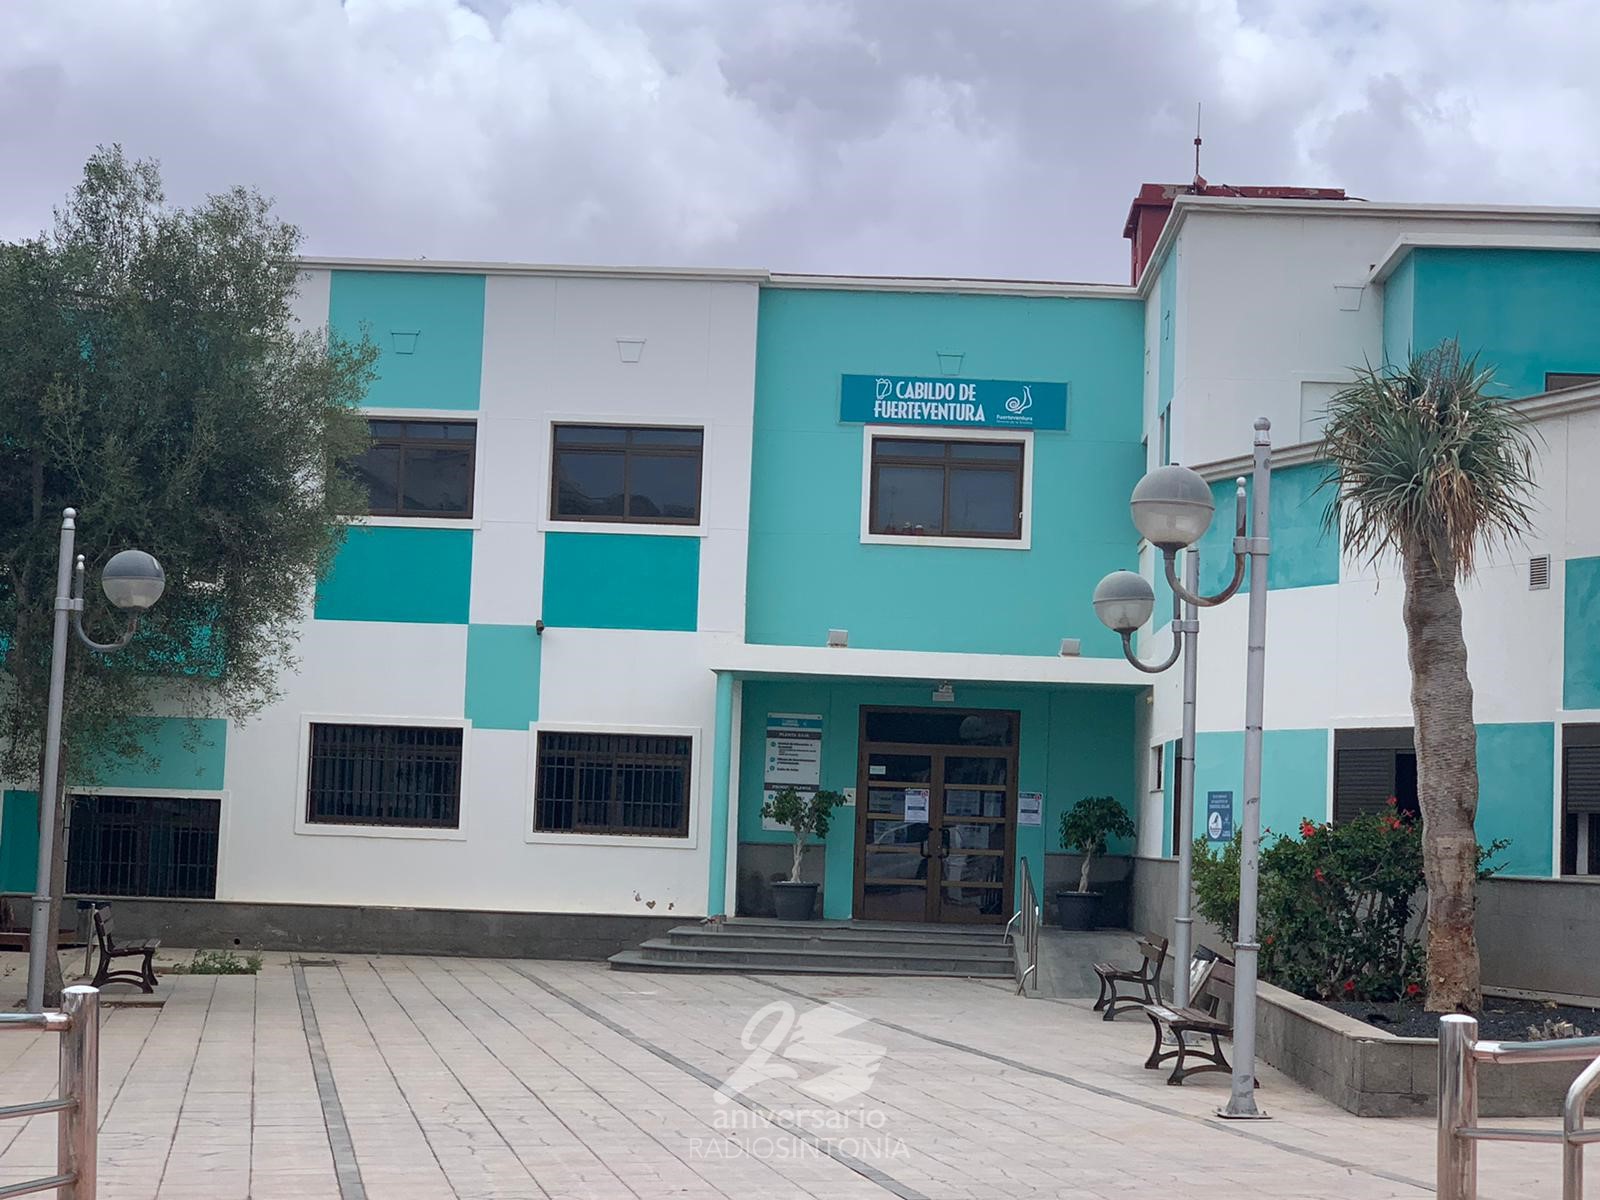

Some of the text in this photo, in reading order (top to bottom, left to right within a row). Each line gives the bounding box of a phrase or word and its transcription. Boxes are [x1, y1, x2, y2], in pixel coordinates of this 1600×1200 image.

[895, 381, 976, 402] CABILDO DE
[874, 400, 985, 422] FUERTEVENTURA
